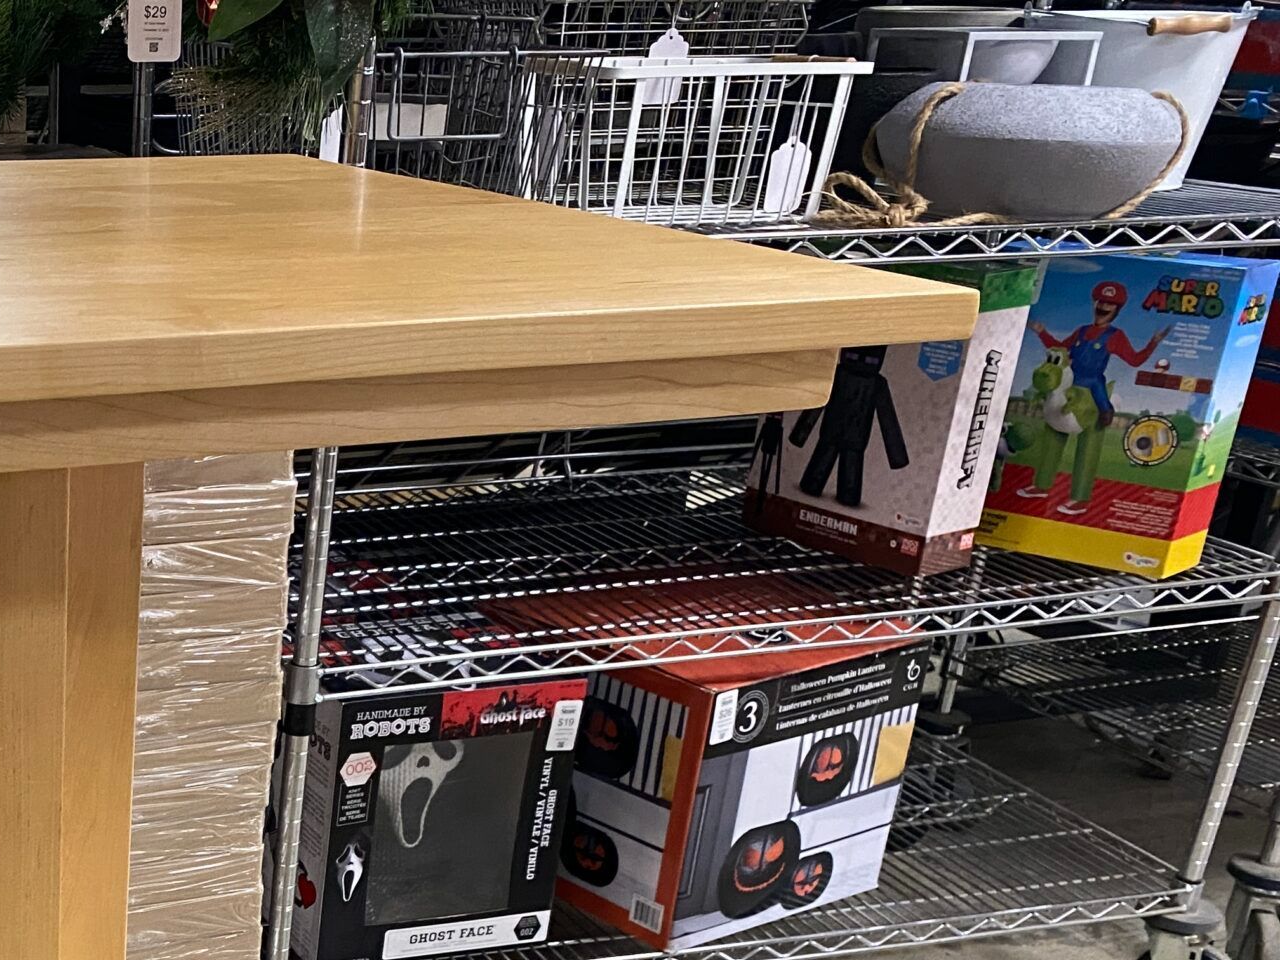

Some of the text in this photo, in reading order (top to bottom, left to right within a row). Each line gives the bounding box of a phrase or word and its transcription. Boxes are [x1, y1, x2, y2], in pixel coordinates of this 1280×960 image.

[144, 5, 167, 19] $29
[1158, 275, 1220, 297] SUPER
[1142, 289, 1225, 319] MARIO
[957, 349, 1002, 490] MINECRAFT
[799, 508, 858, 536] ENDERMAN
[791, 662, 886, 693] Halloween Pumpkin Lanterns
[357, 706, 427, 721] HANDMADE BY
[776, 714, 807, 731] Linternas
[856, 694, 889, 709] Halloween
[779, 696, 812, 713] Lanternes
[823, 687, 852, 703] citrouille
[350, 717, 431, 740] ROBOTS
[557, 718, 575, 727] $19
[739, 701, 759, 733] 3
[539, 757, 554, 789] VINYL
[540, 789, 557, 847] GHOST FACE
[409, 925, 494, 945] GHOST FACE
